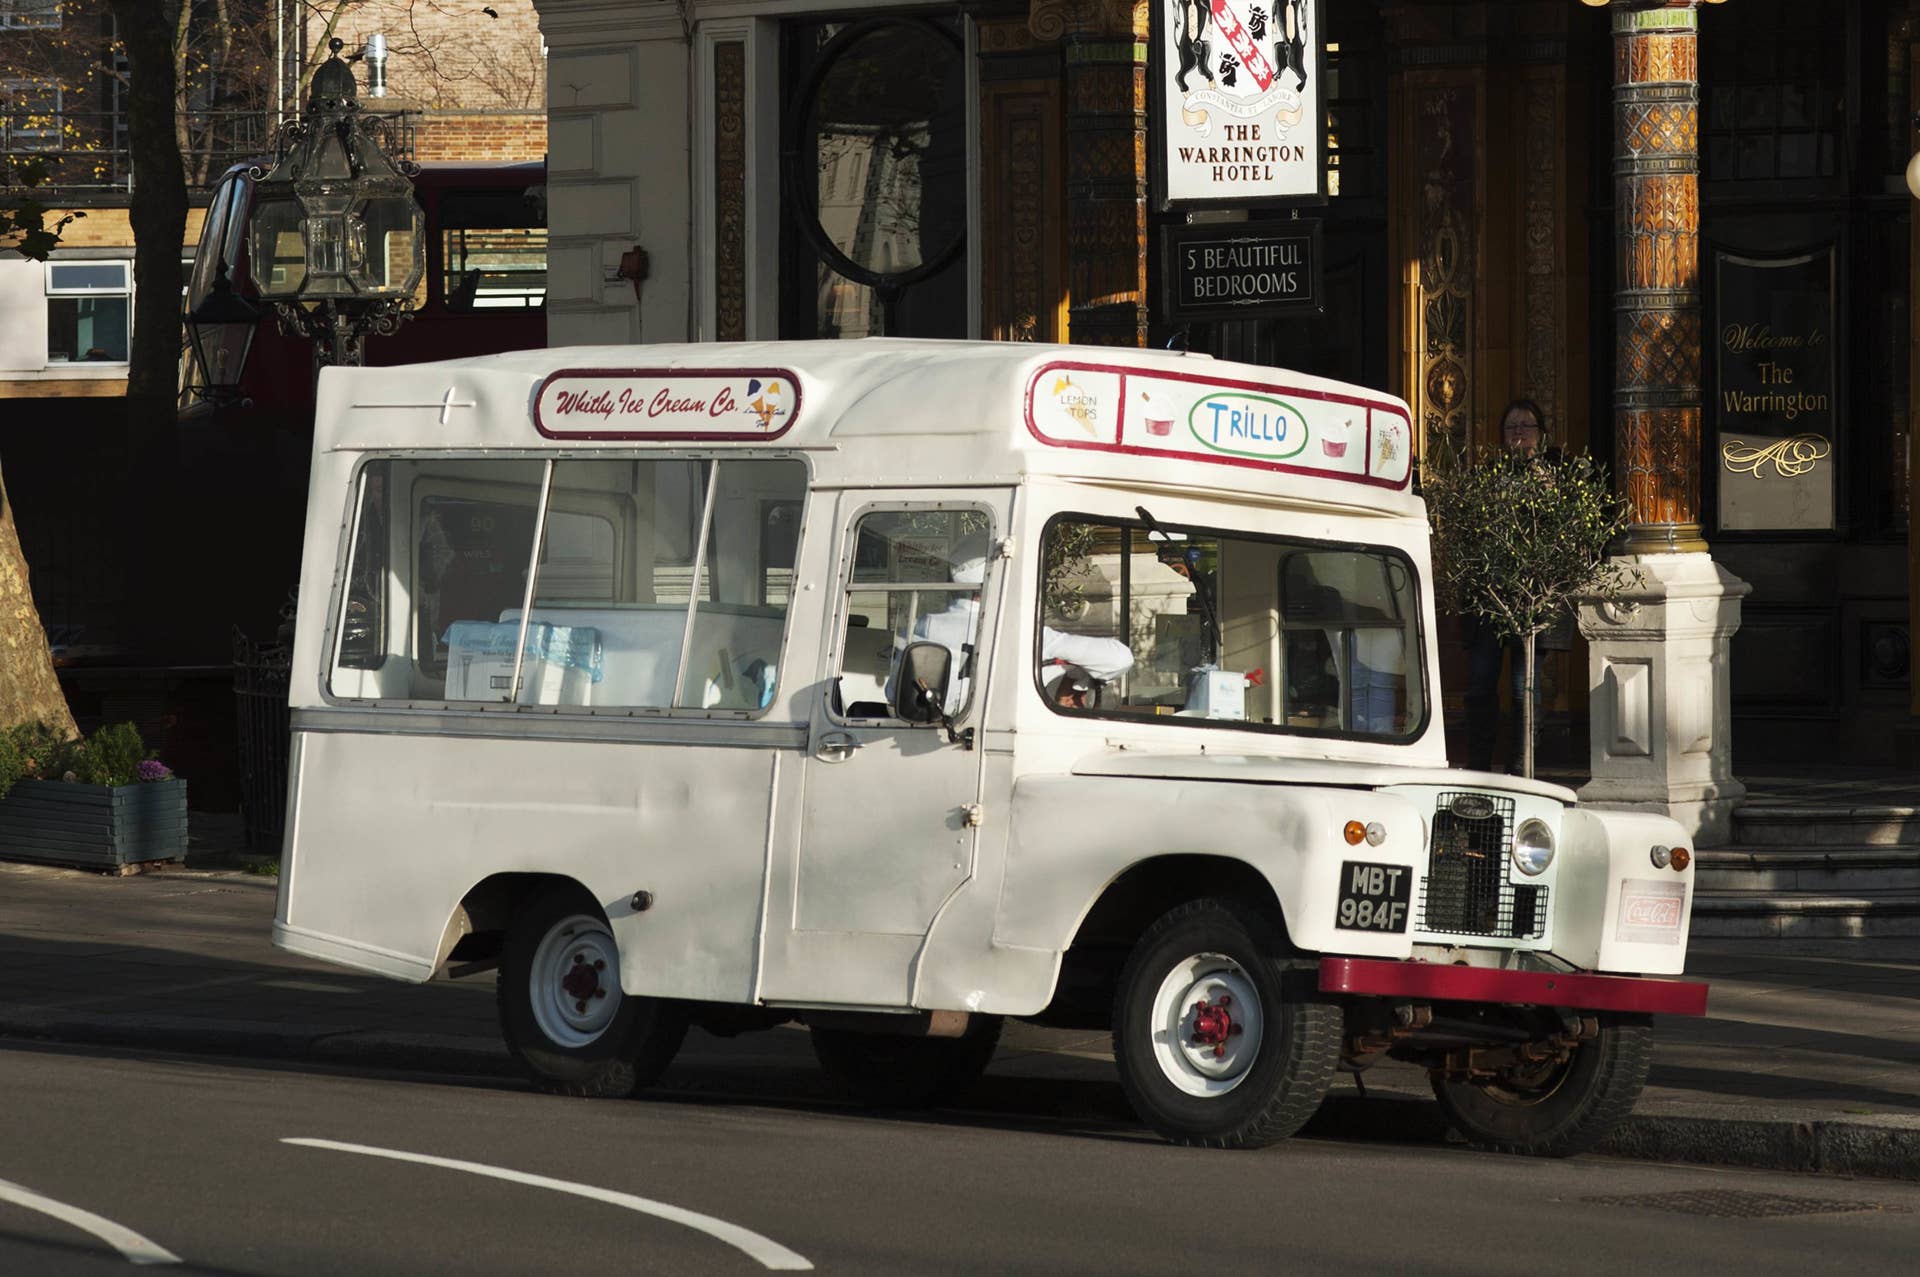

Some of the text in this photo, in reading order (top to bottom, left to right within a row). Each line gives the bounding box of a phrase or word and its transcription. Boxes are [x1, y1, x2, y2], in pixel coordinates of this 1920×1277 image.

[1224, 125, 1261, 141] THE
[1178, 146, 1304, 163] WARRINGTON
[1212, 165, 1274, 182] HOTEL
[1187, 245, 1302, 270] 5 BEAUTIFUL
[1194, 272, 1297, 297] BEDROOMS
[1722, 323, 1825, 354] Welcome to
[1758, 361, 1793, 384] The
[556, 386, 738, 420] Whitby Ice Cream Co.
[1060, 395, 1097, 406] LEMON
[1724, 390, 1827, 420] Warrington
[1070, 407, 1097, 420] TOPS
[1351, 865, 1402, 897] MBT
[1340, 900, 1406, 930] 984F
